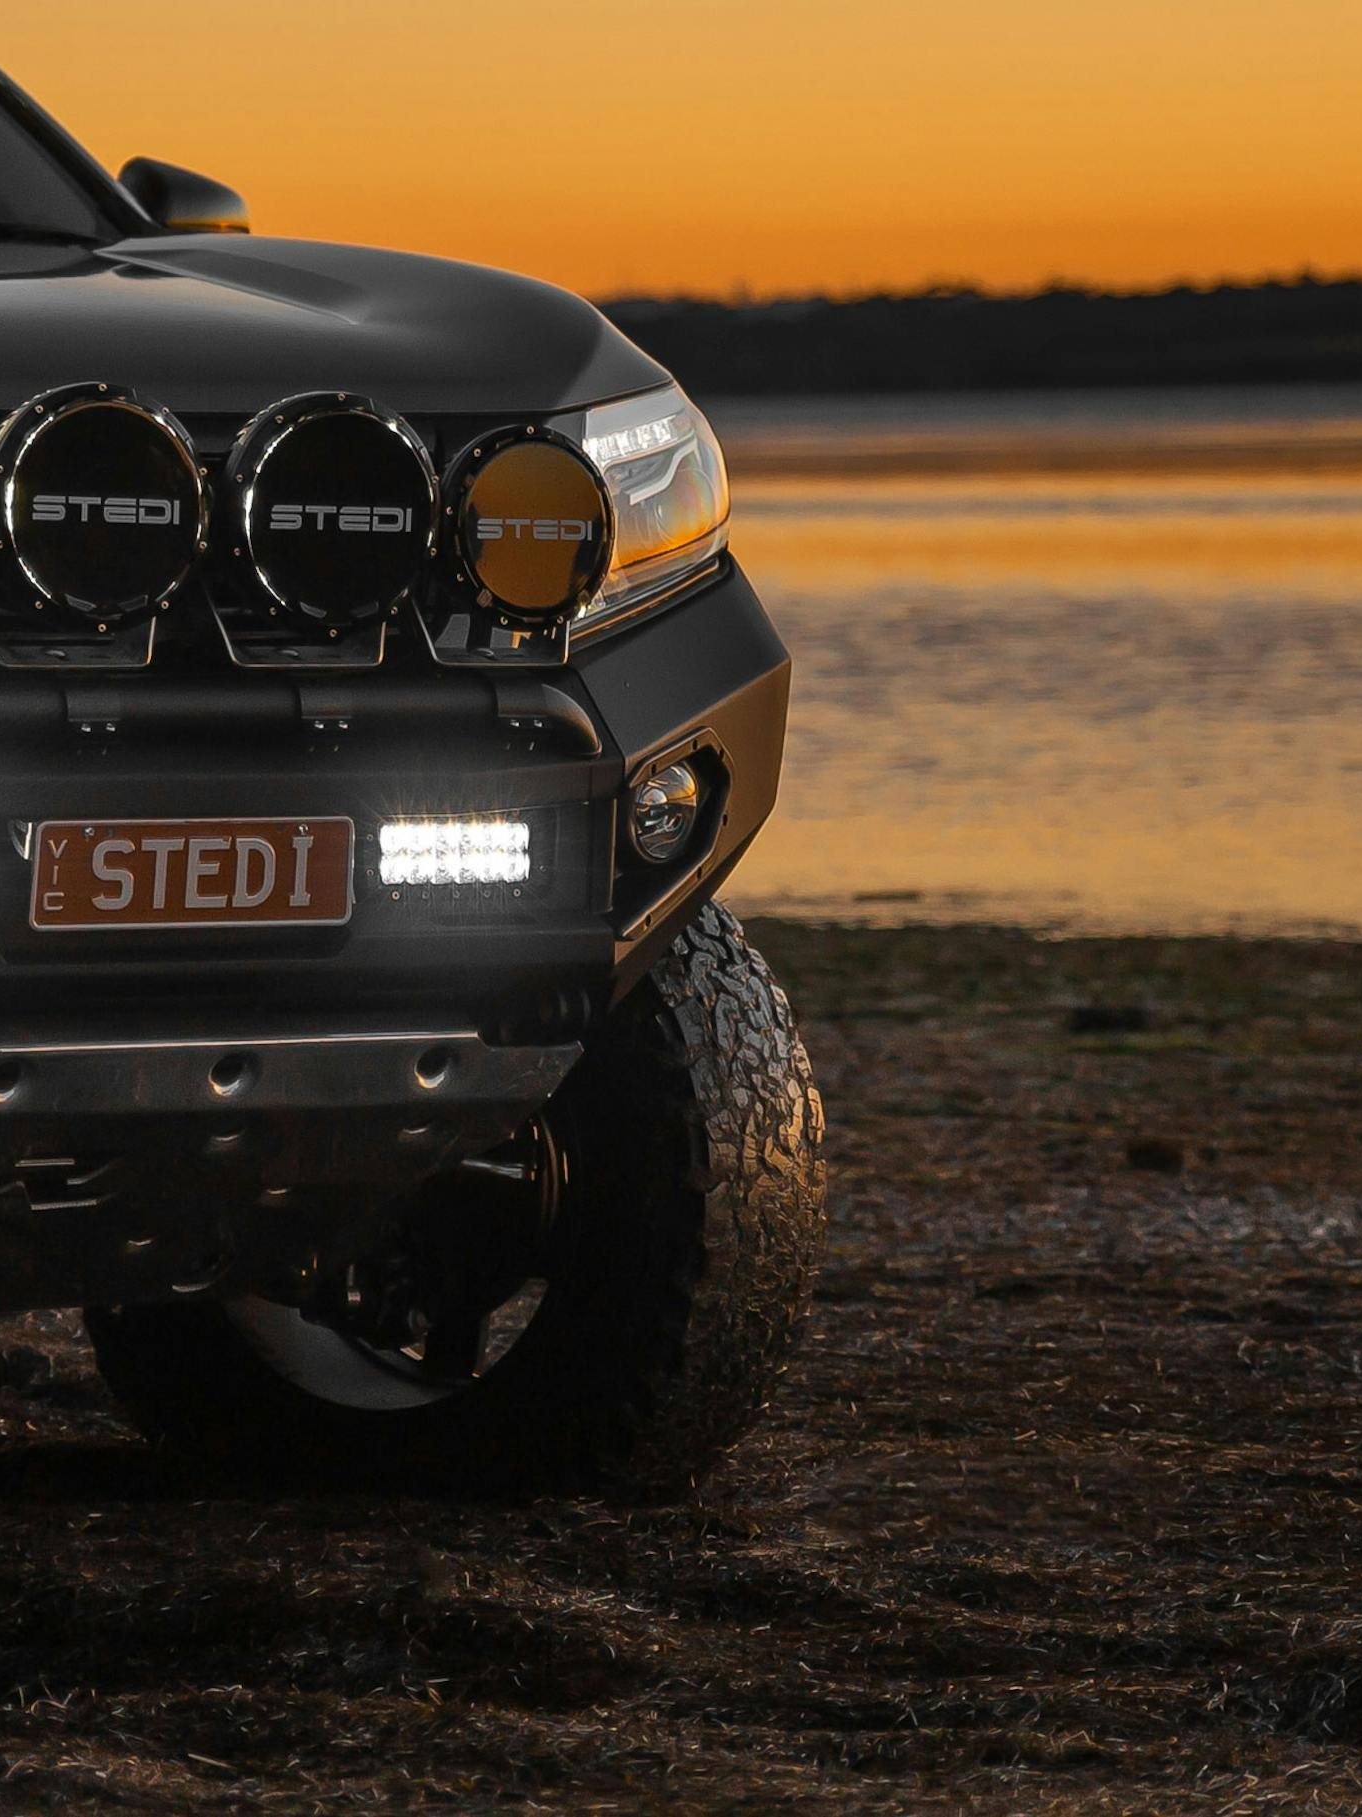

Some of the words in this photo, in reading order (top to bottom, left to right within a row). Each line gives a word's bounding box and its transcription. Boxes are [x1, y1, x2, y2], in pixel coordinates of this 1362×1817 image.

[32, 494, 180, 526] STEDI
[268, 504, 413, 533] STEDI
[476, 517, 593, 542] STEDI
[42, 838, 69, 912] VIC
[90, 834, 315, 911] STEDI
